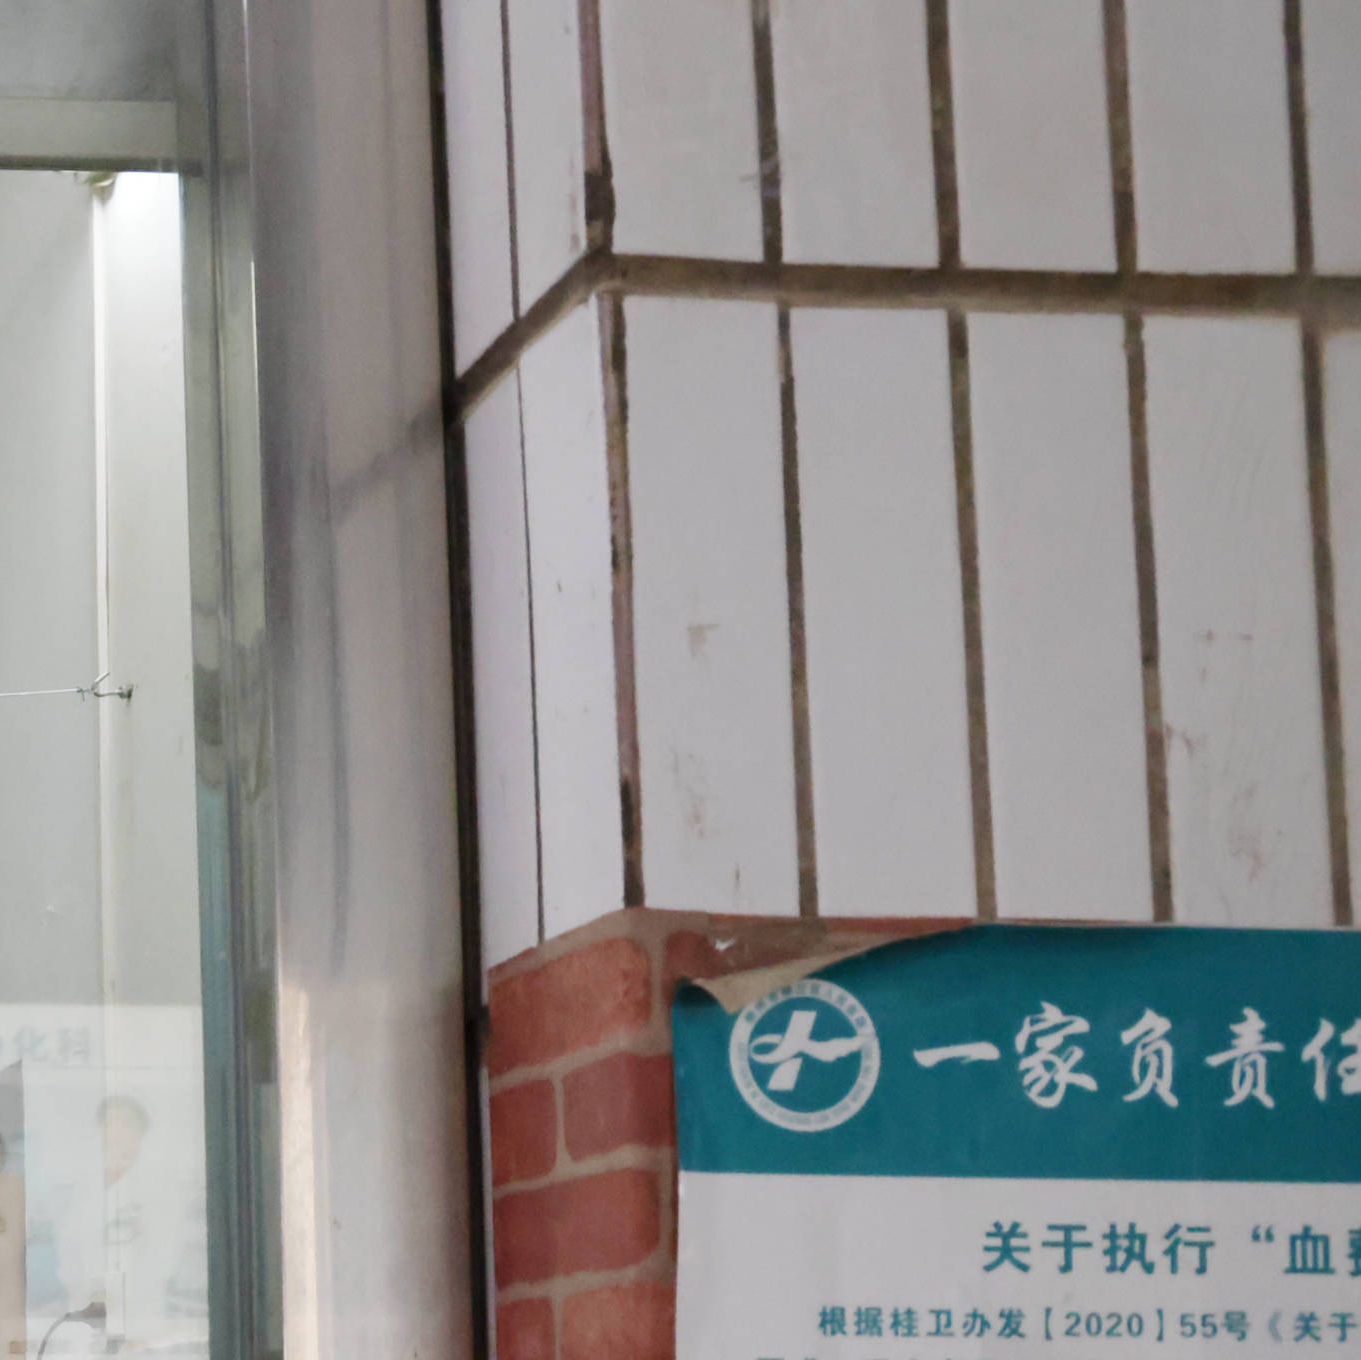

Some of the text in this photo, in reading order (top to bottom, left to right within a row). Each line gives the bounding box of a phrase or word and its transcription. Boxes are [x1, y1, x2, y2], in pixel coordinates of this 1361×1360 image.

[913, 1002, 1361, 1109] 一家负责任
[982, 1220, 1361, 1278] 关于执行“血
